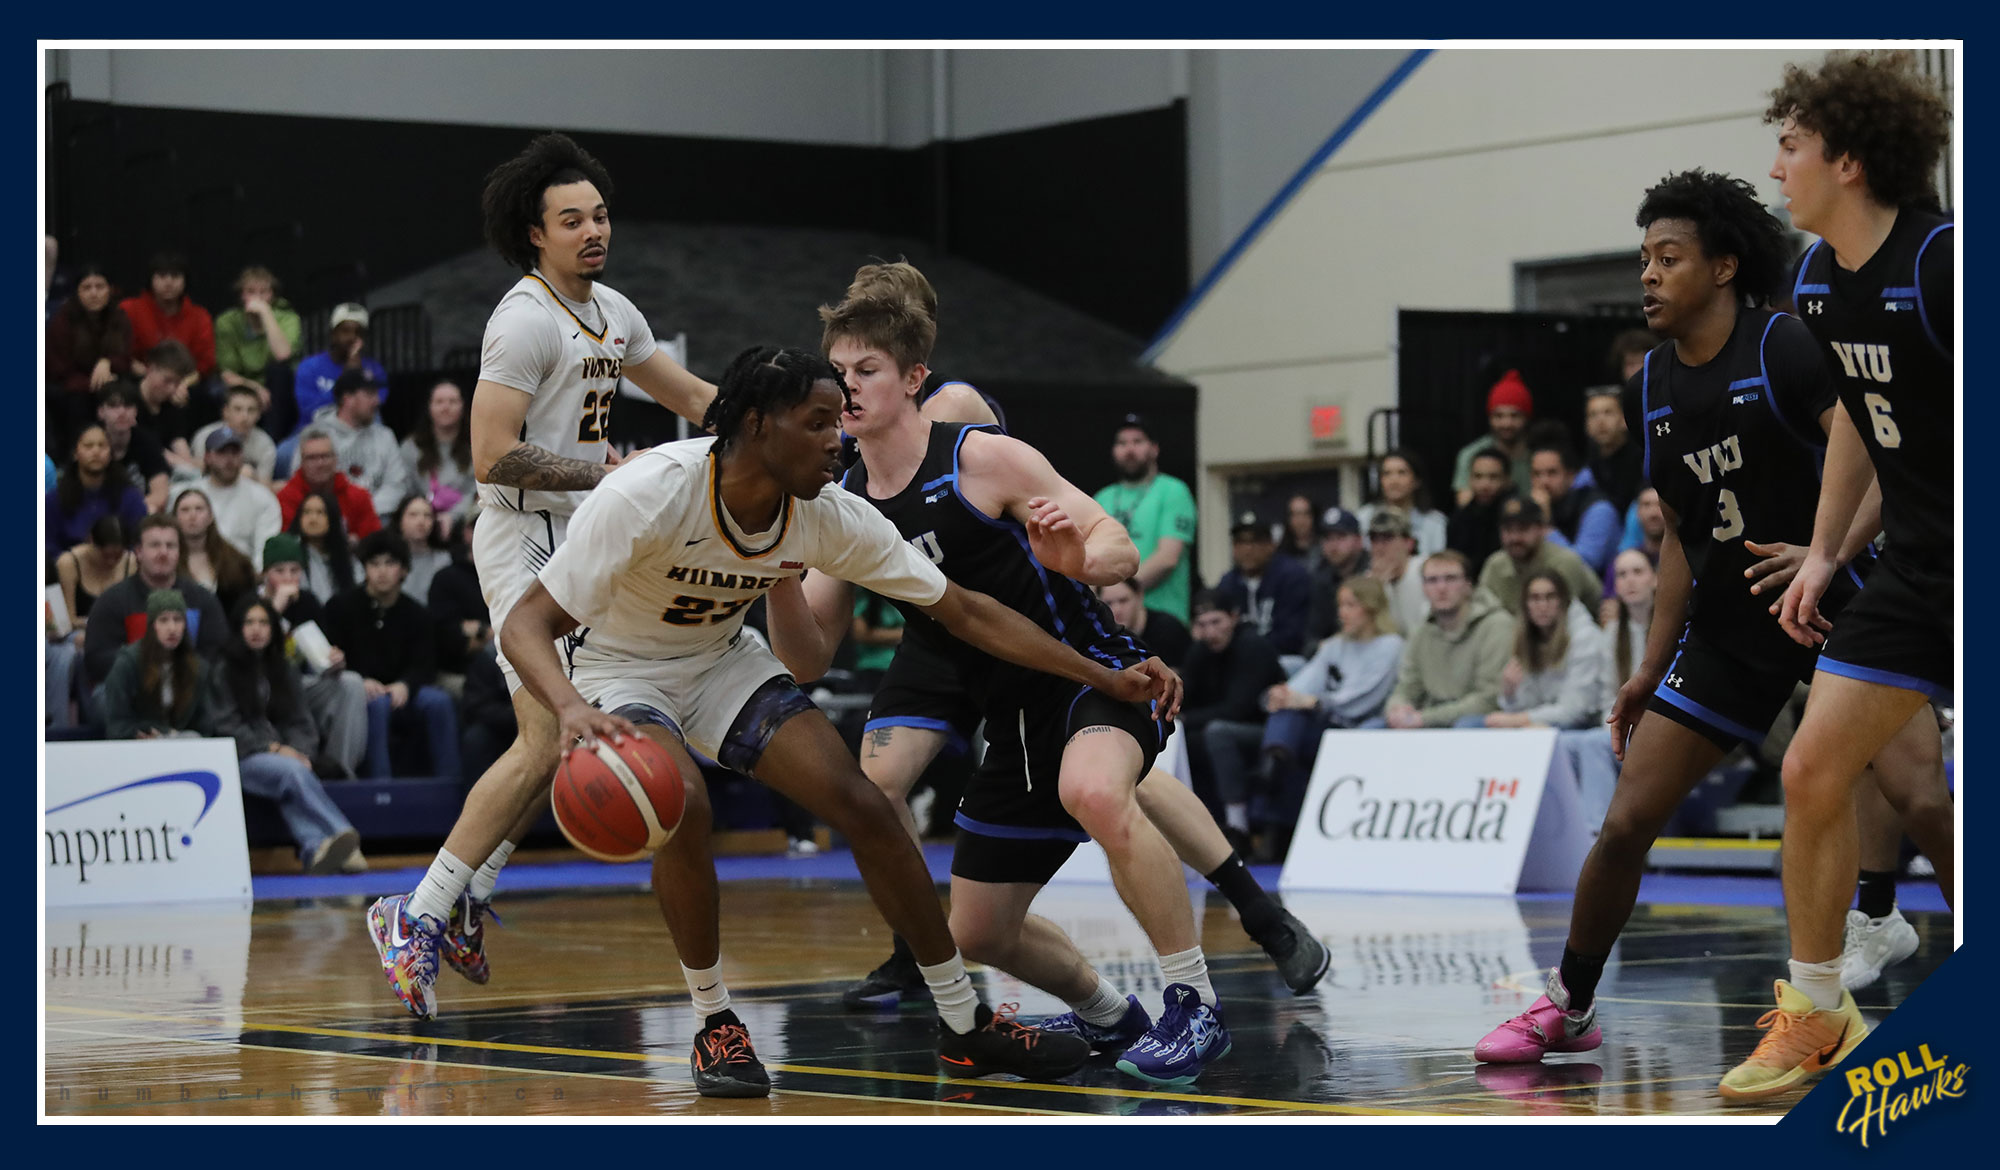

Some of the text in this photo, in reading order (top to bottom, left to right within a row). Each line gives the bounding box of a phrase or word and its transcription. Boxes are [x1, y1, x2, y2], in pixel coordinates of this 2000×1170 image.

[1830, 341, 1893, 383] VIU
[1864, 392, 1901, 448] 6
[1683, 434, 1743, 484] VIU
[1712, 488, 1745, 542] 3
[665, 565, 781, 590] HUMBE
[1318, 774, 1508, 842] Canada
